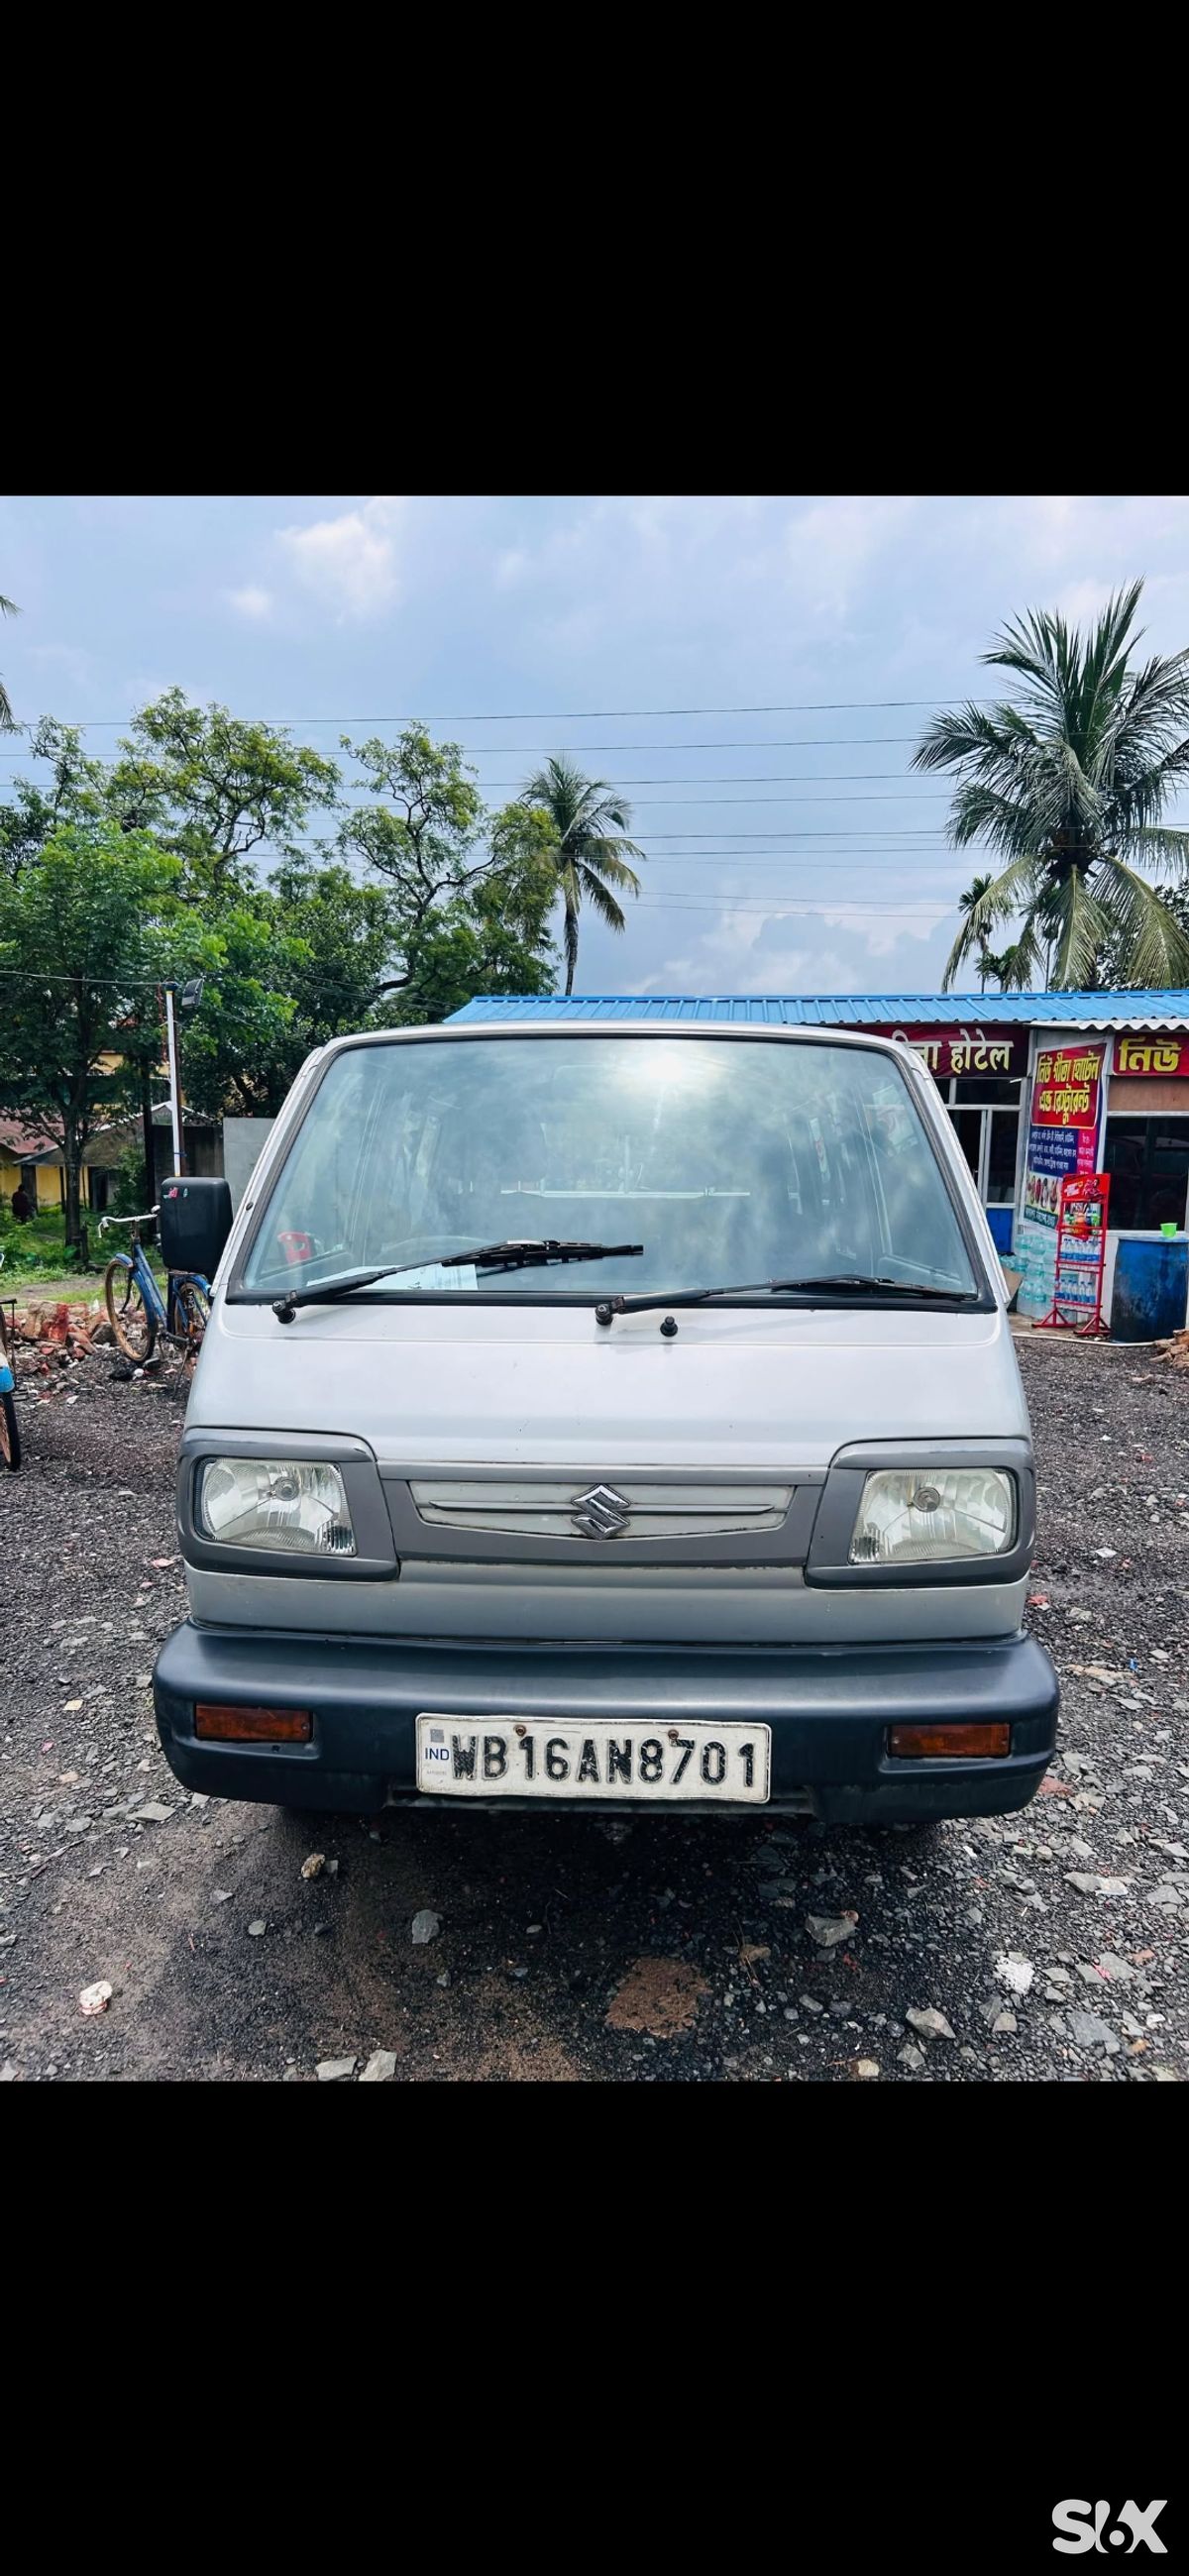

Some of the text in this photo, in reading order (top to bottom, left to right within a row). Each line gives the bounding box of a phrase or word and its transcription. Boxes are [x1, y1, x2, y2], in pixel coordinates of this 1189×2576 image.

[948, 1027, 1015, 1074] होटेल
[1036, 1054, 1052, 1083] নিউ
[1119, 1036, 1182, 1072] নিউ
[425, 1735, 755, 1787] IND WB16AN8701
